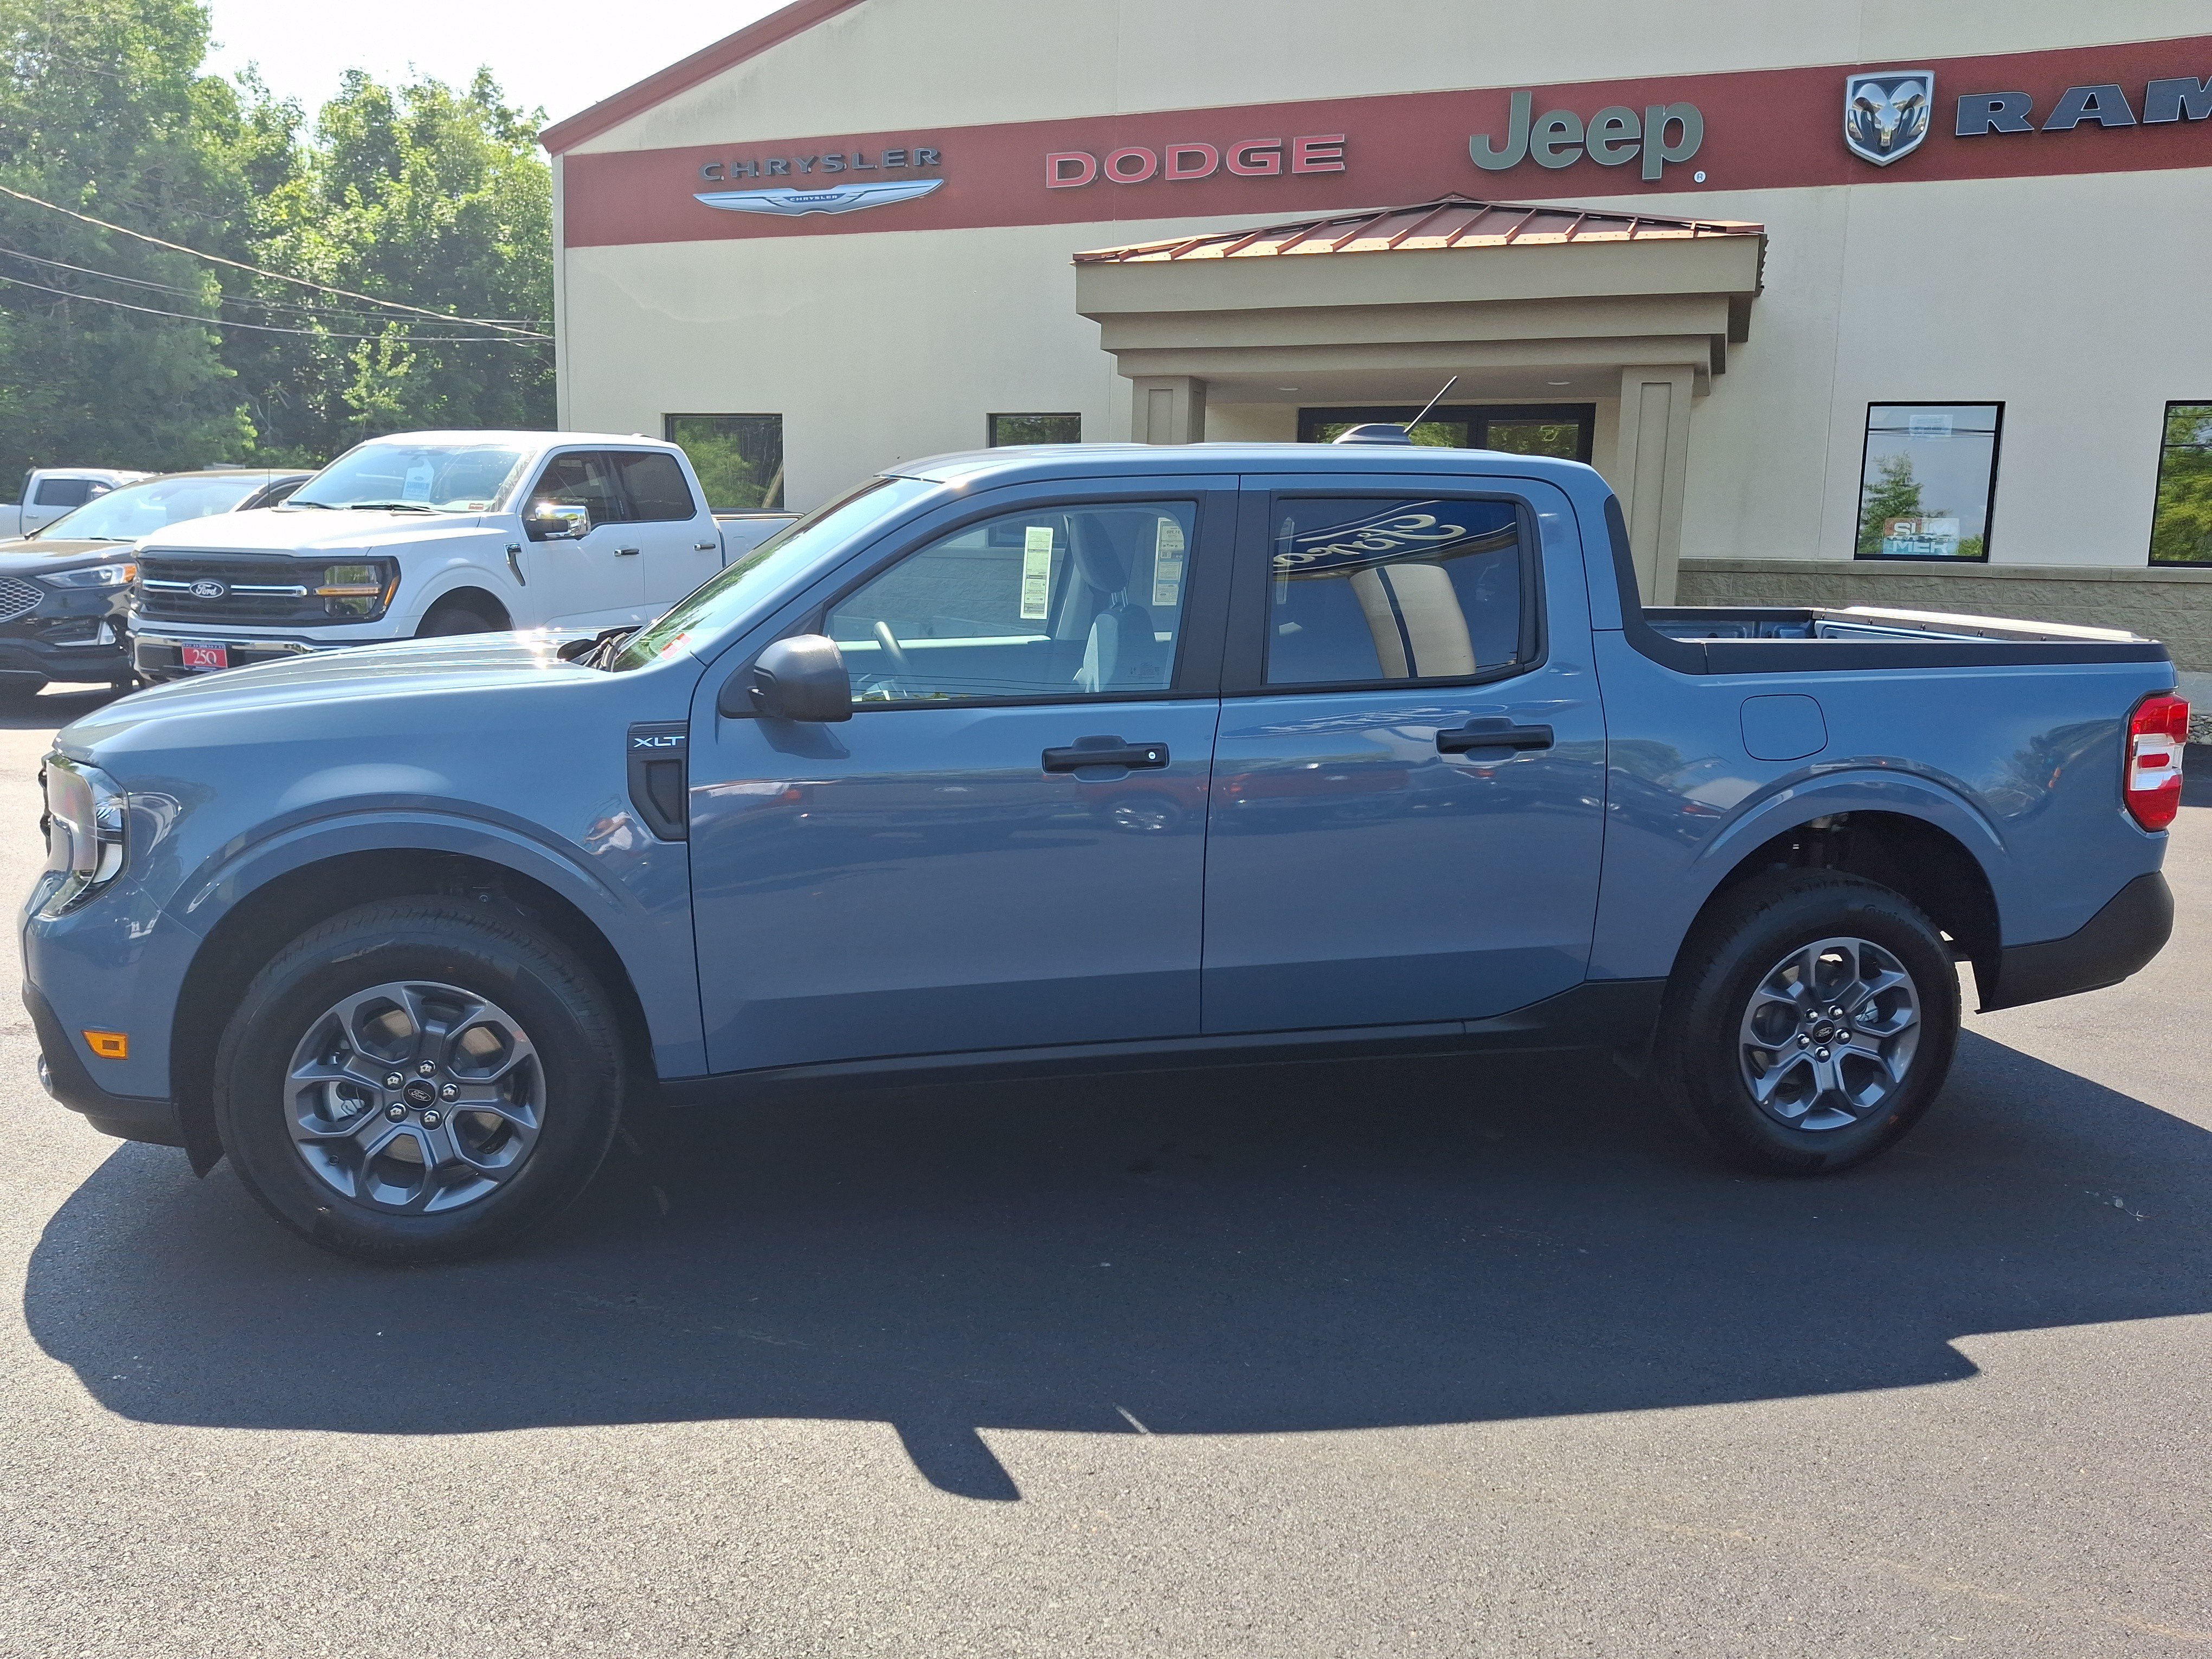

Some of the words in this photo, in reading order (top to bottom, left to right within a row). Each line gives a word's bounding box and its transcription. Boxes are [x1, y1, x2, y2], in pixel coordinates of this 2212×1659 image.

[1469, 91, 1703, 180] Jeep
[698, 147, 941, 181] CHRYSLER
[1046, 133, 1346, 189] DODGE
[196, 583, 217, 595] Ford
[633, 736, 685, 748] XLT
[411, 1090, 427, 1099] Ford
